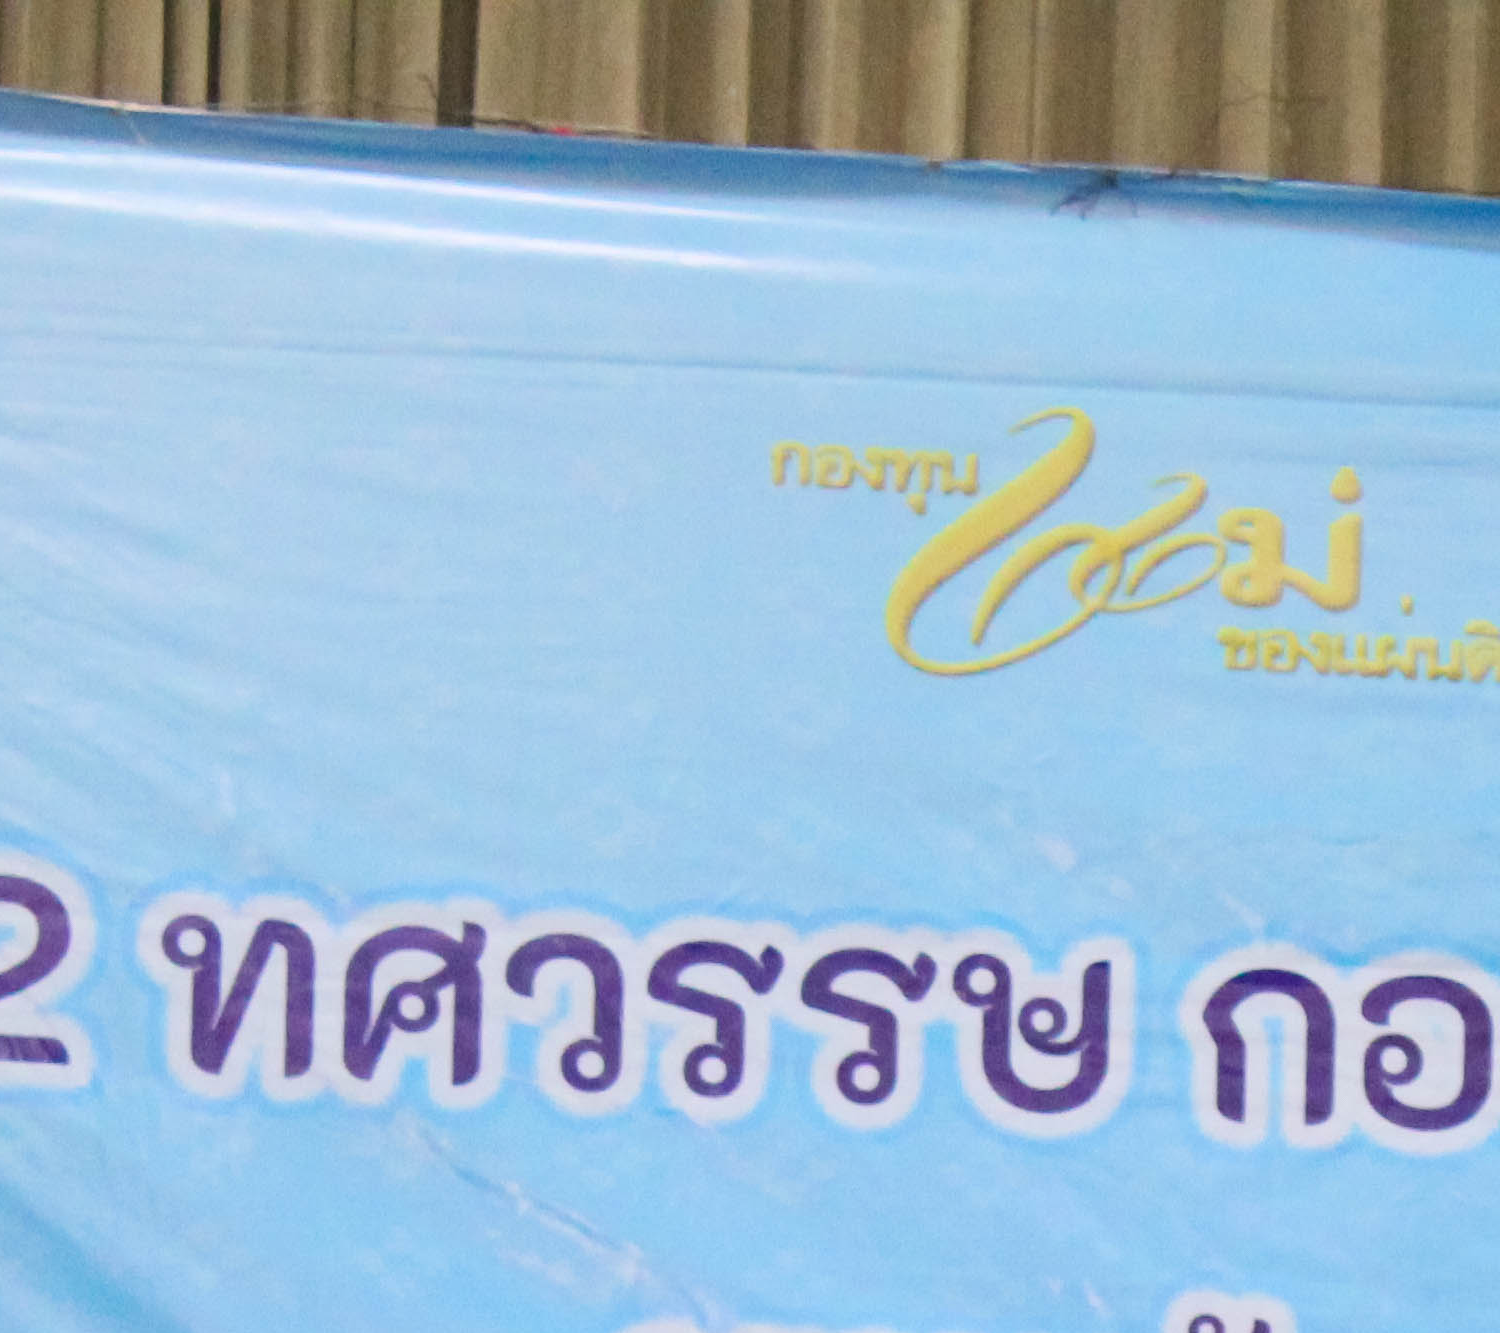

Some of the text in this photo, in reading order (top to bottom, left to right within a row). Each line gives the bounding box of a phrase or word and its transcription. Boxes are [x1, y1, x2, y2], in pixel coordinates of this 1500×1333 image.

[770, 441, 979, 514] กองทุน
[159, 911, 1112, 1113] ทศวรรษ
